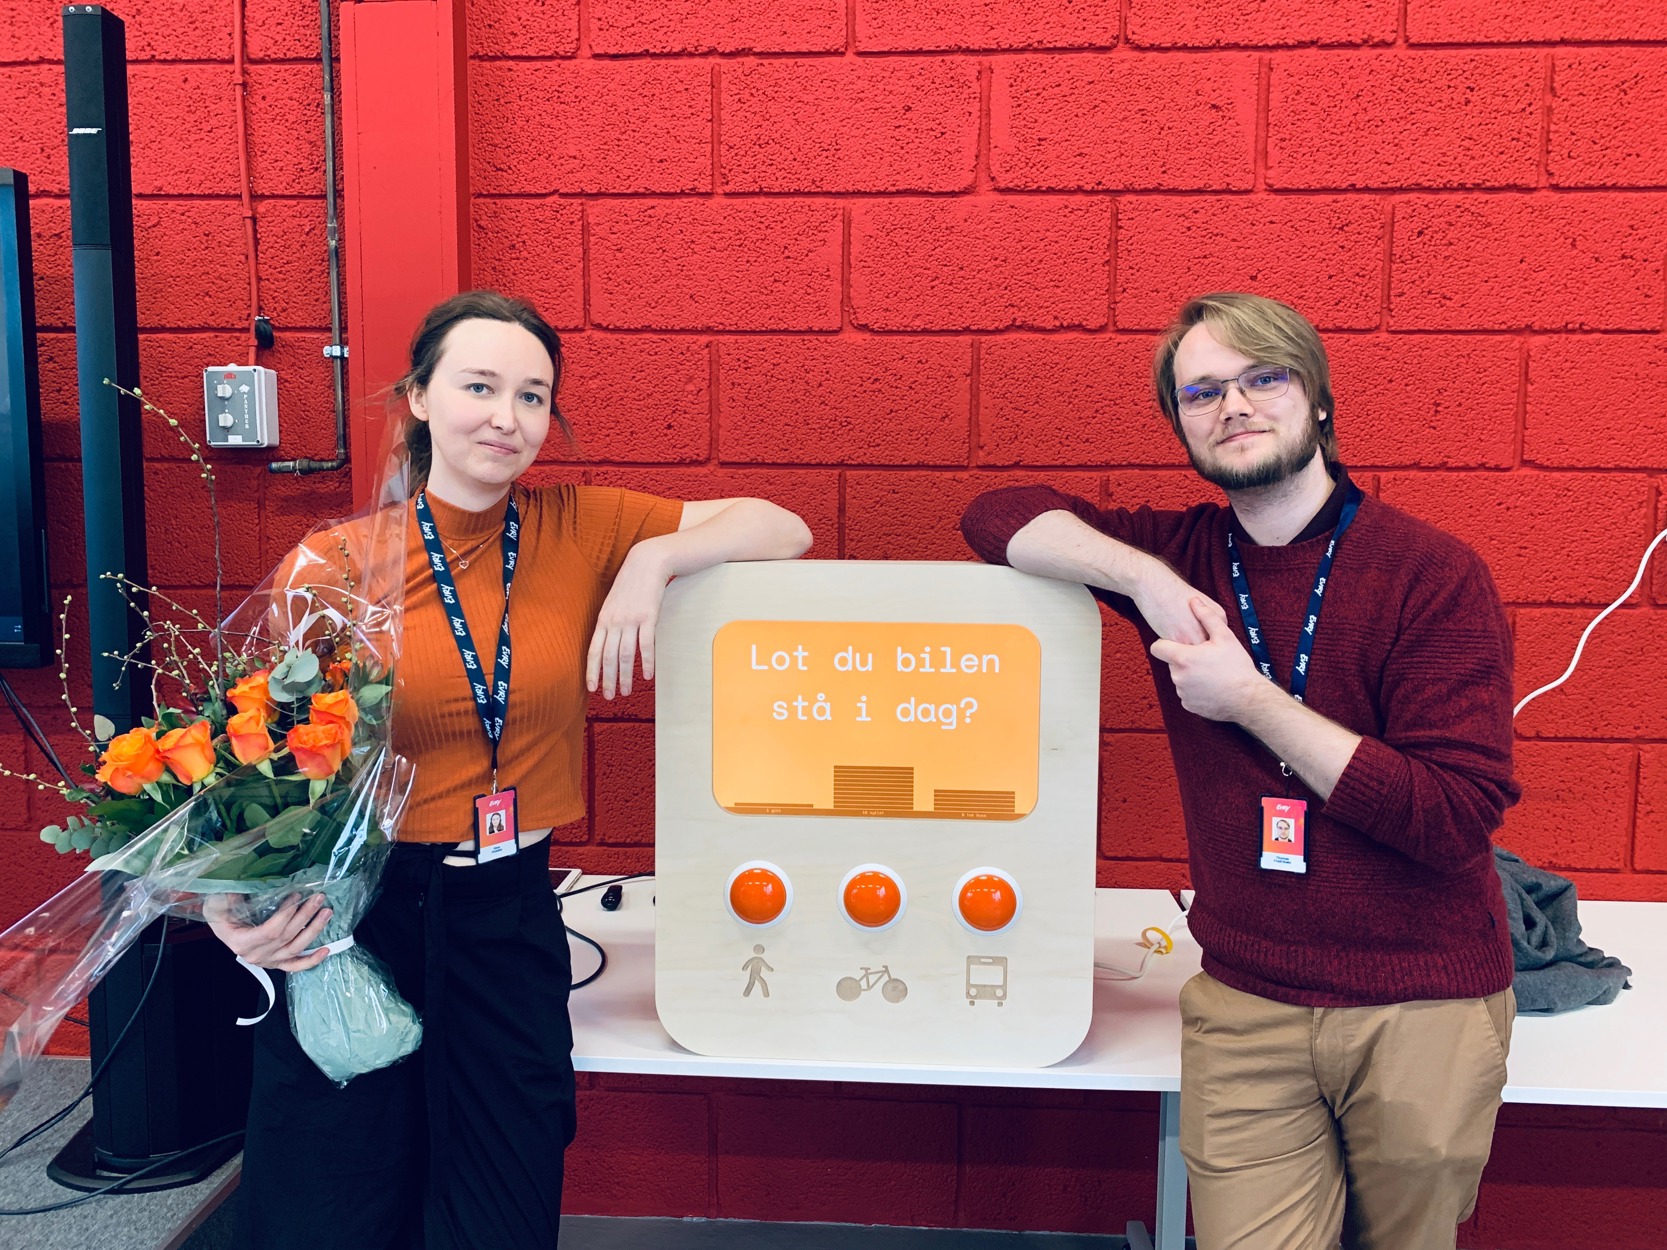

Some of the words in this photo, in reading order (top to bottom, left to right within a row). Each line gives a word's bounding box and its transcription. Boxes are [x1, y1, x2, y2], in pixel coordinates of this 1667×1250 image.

[751, 644, 809, 671] Lot
[833, 645, 873, 672] du
[896, 646, 1000, 673] bilen
[772, 693, 832, 721] stå
[855, 695, 872, 722] i
[895, 697, 979, 730] dag?
